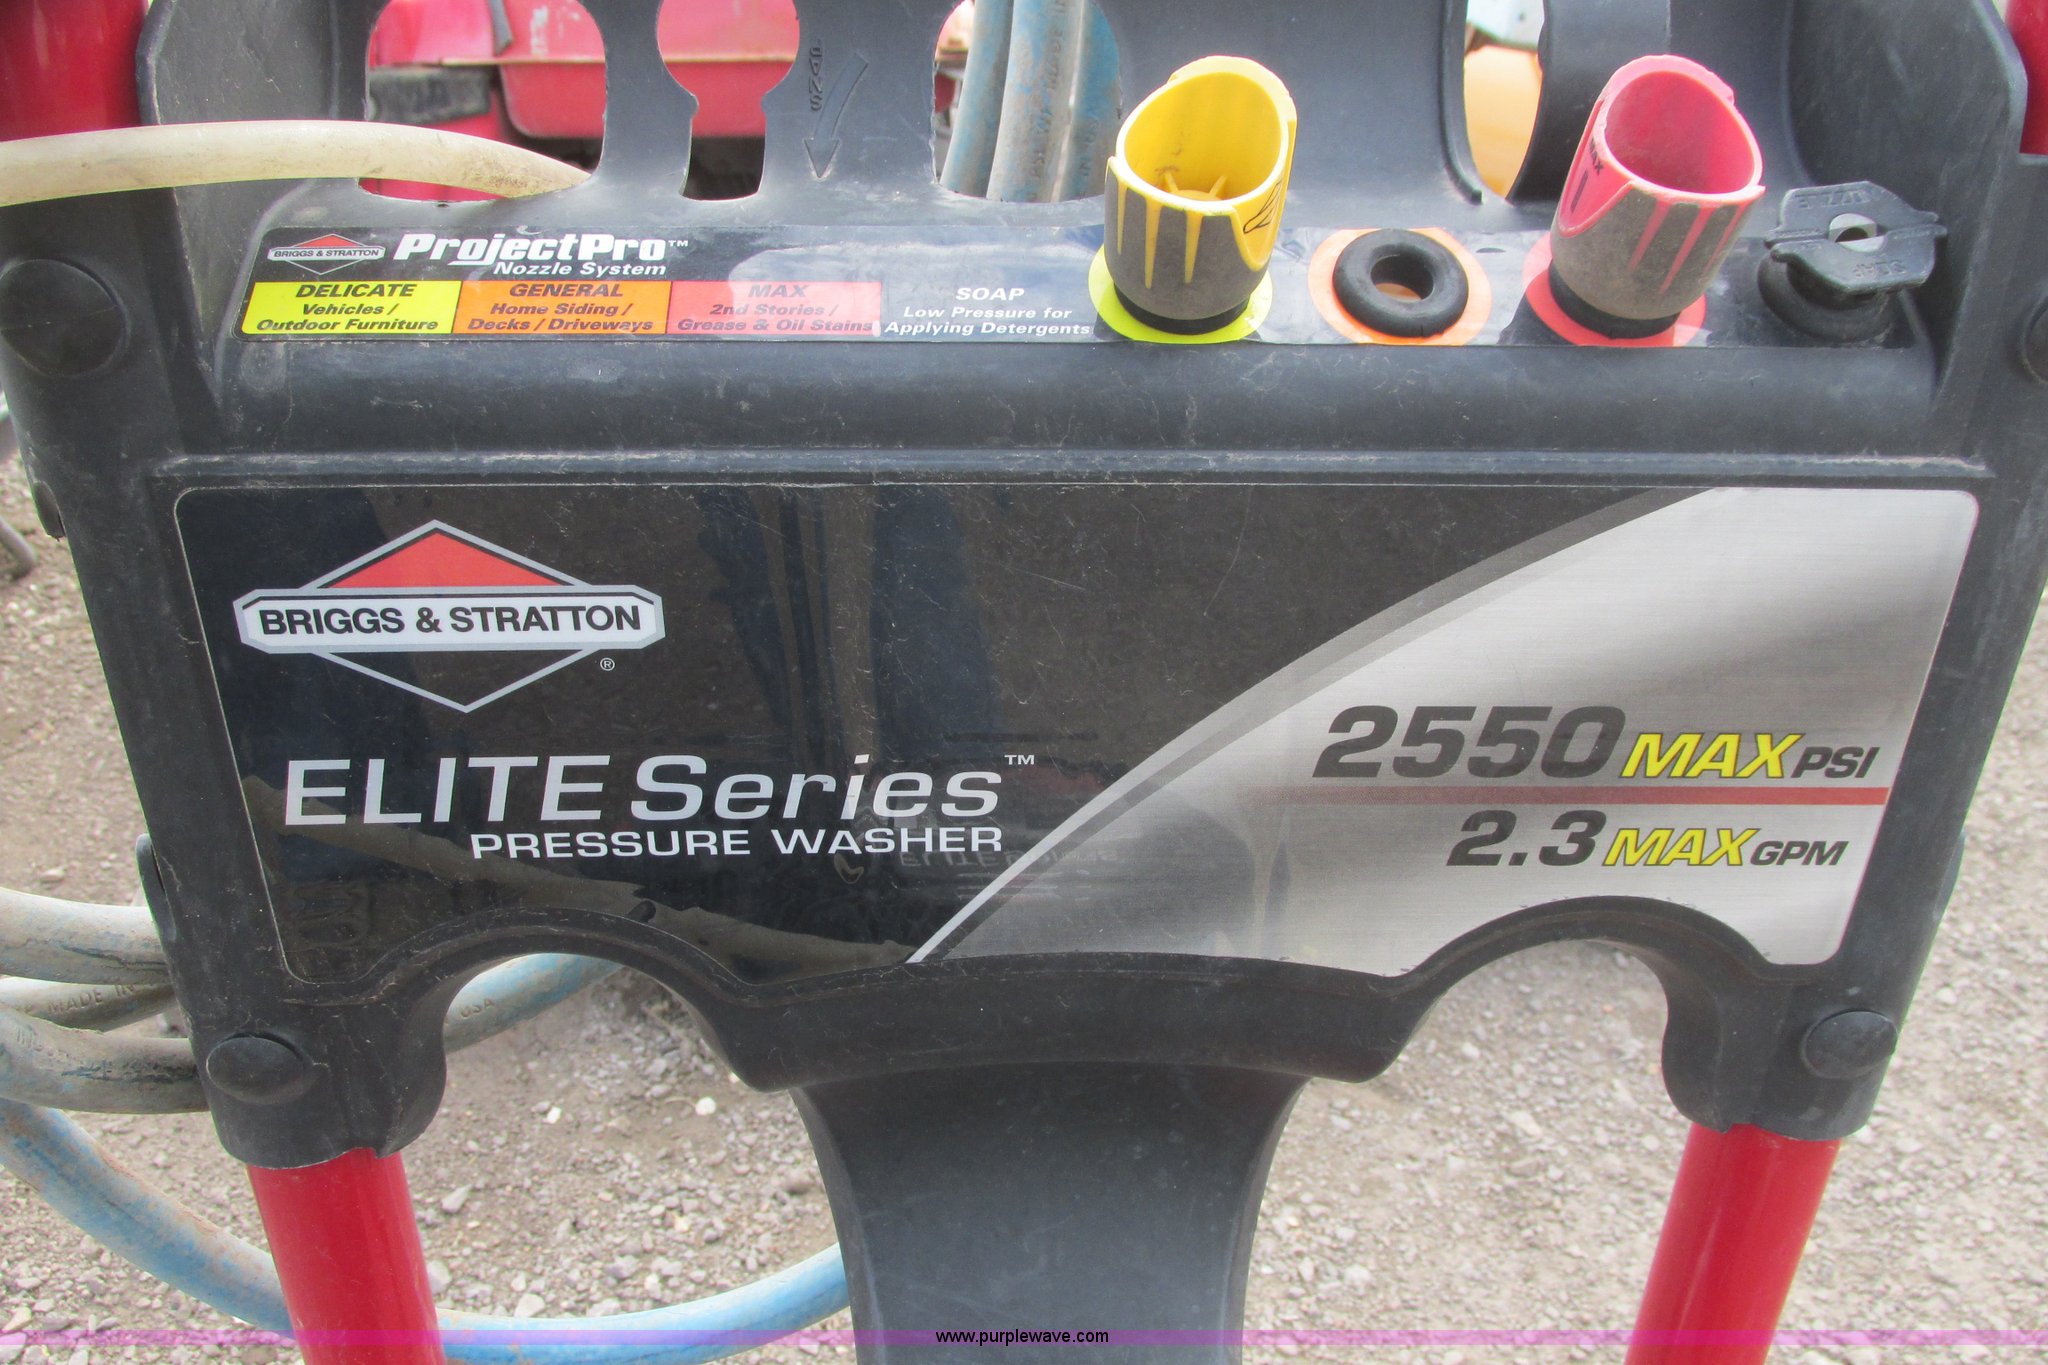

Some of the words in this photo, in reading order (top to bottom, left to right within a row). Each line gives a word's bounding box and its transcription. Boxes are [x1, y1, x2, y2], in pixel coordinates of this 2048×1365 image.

[273, 249, 313, 258] BRIGGS
[314, 249, 324, 257] &
[326, 248, 379, 257] STRATTON
[393, 233, 667, 266] ProjectPro
[494, 262, 572, 275] Nozzle
[579, 262, 667, 277] System
[295, 284, 417, 298] DELICATE
[509, 283, 624, 297] GENERAL
[748, 284, 809, 298] MAX
[956, 287, 1025, 301] SOAP
[302, 302, 387, 315] Vehicles
[491, 303, 547, 315] Home
[555, 302, 620, 317] Siding
[709, 304, 749, 316] 2nd
[754, 304, 825, 316] Stories
[903, 306, 948, 319] Low
[952, 306, 1037, 319] Pressure
[1042, 306, 1073, 319] for
[257, 319, 342, 331] Outdoor
[345, 318, 439, 331] Furniture
[468, 319, 531, 331] Decks
[548, 318, 653, 332] Driveways
[678, 319, 749, 331] Grease
[752, 319, 769, 331] &
[776, 318, 805, 331] Oil
[810, 318, 873, 331] Stains
[884, 321, 975, 338] Applying
[979, 321, 1091, 338] Detergents
[259, 607, 405, 636] BRIGGS
[416, 607, 440, 633] &
[450, 605, 641, 632] STRATTON
[1312, 705, 1627, 778] 2550
[1619, 733, 1804, 779] MAX
[1792, 746, 1879, 778] PSI
[285, 755, 611, 826] ELITE
[630, 754, 1002, 821] Series
[470, 830, 751, 859] PRESSURE
[772, 827, 1002, 855] WASHER
[1446, 810, 1606, 867] 2.3
[1601, 827, 1760, 867] MAX
[1750, 840, 1849, 866] GPM
